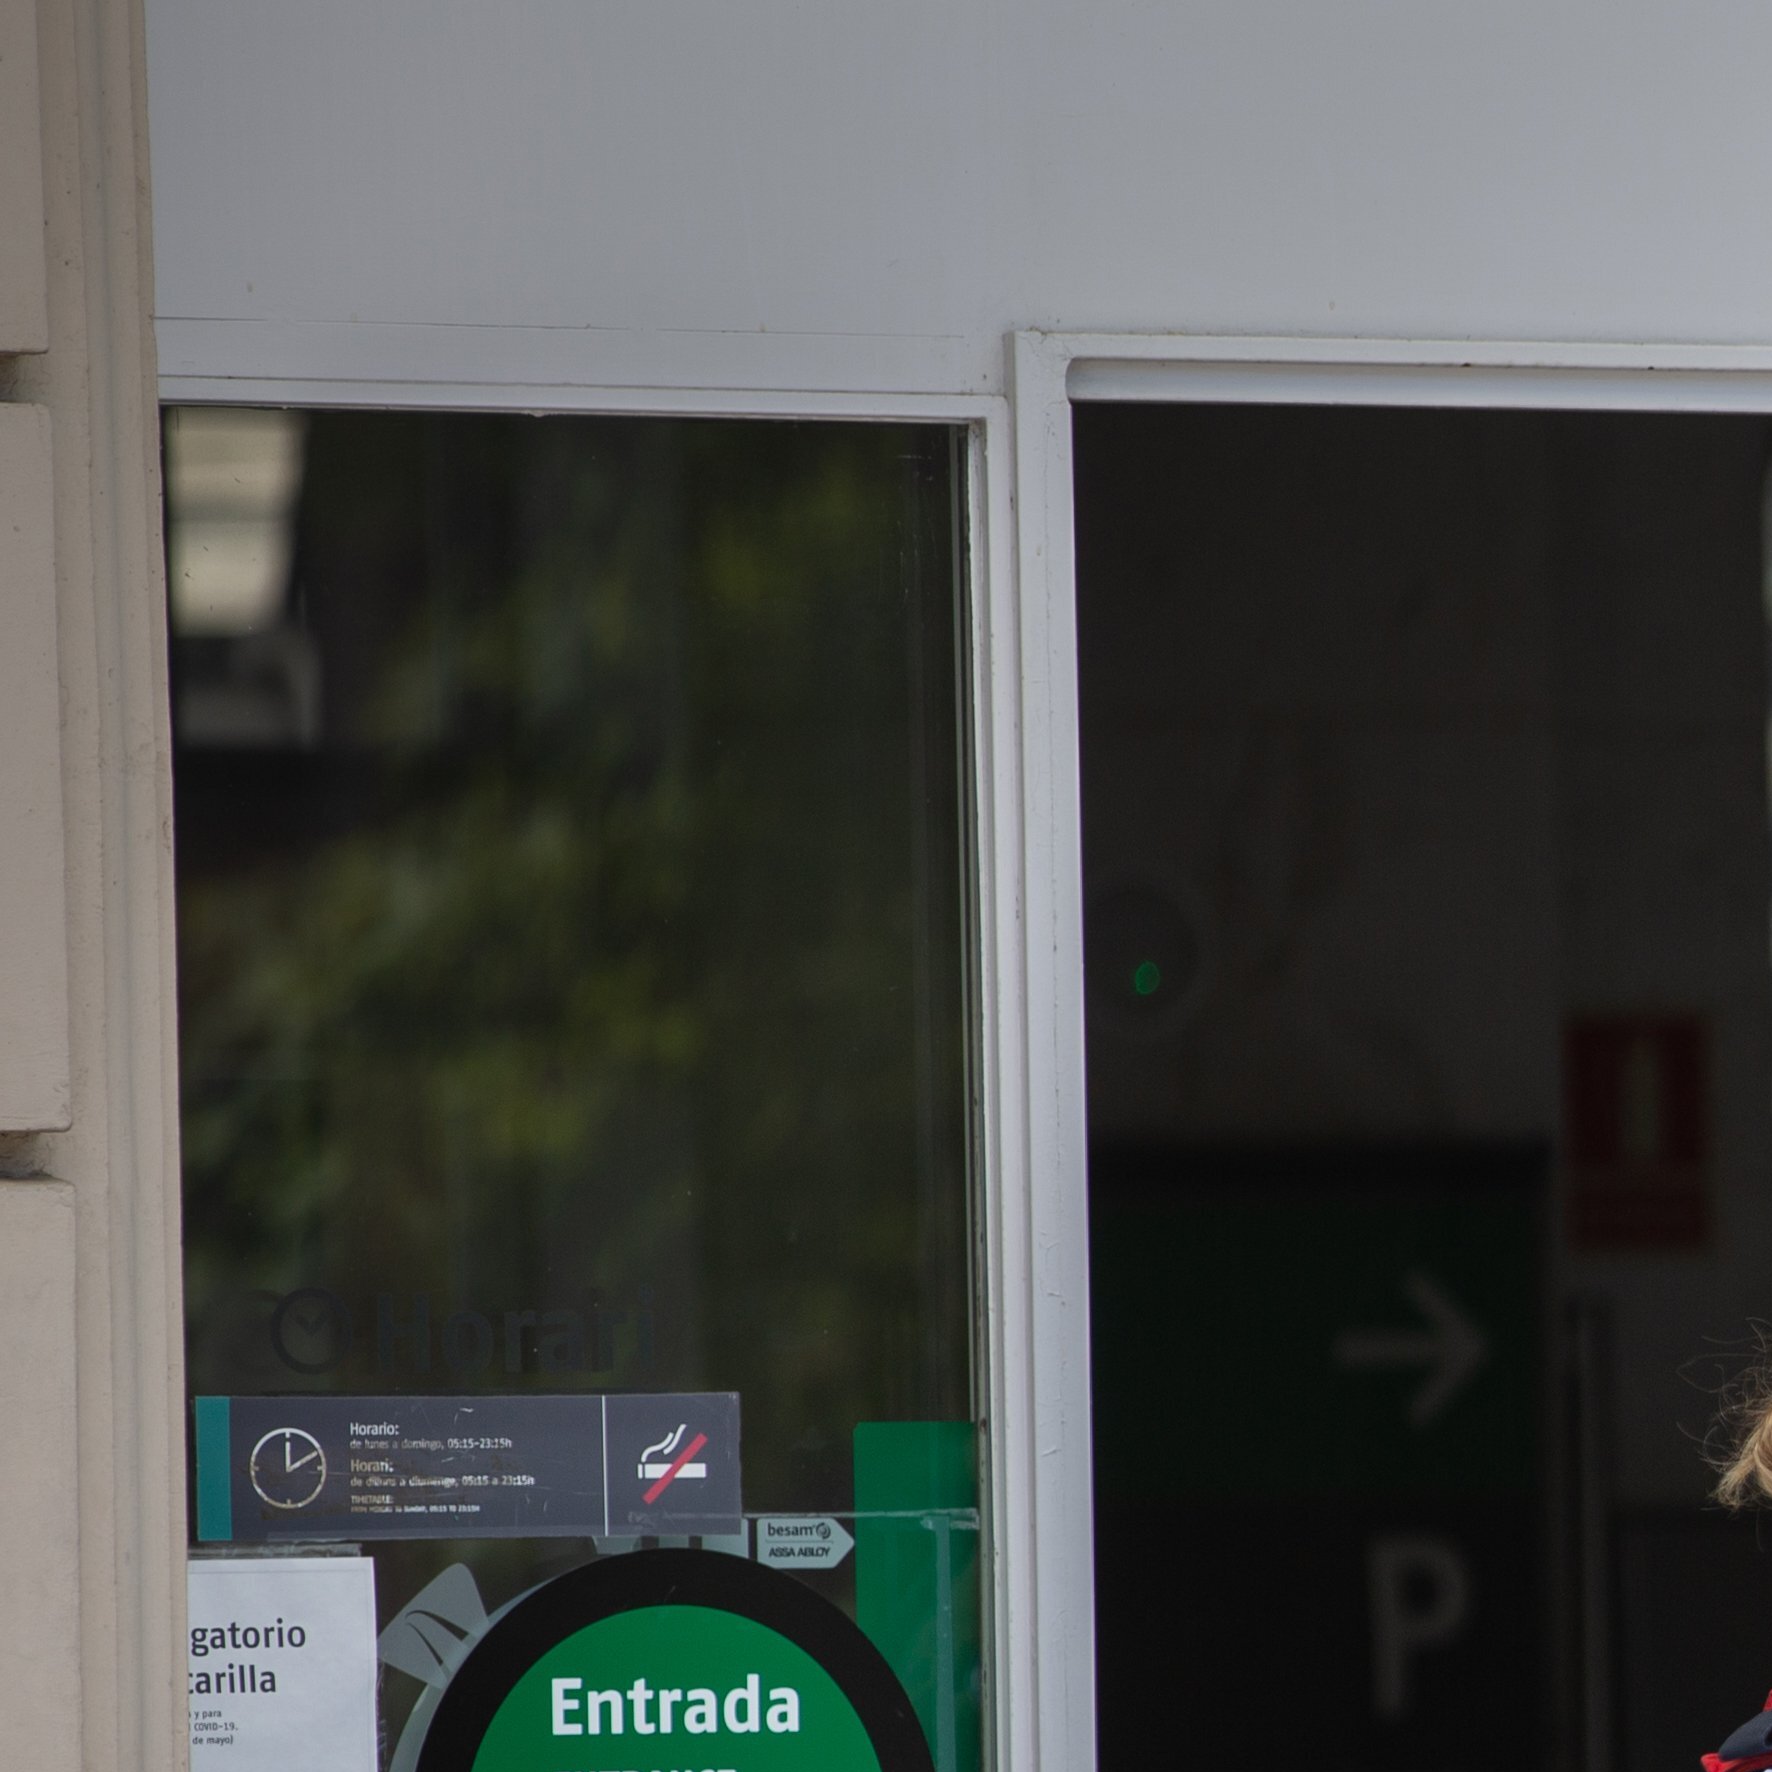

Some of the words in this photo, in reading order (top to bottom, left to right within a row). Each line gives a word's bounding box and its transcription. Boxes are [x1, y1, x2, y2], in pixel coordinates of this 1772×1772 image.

[350, 1422, 400, 1436] Horario:
[350, 1439, 362, 1449] de
[768, 1522, 813, 1536] besam
[769, 1547, 795, 1557] ASSA
[797, 1546, 830, 1557] ABLOY
[1368, 1532, 1474, 1718] P
[191, 1617, 305, 1657] gatorio
[189, 1663, 276, 1694] arilla
[551, 1673, 800, 1735] Entrada
[202, 1710, 221, 1719] para
[194, 1722, 239, 1731] COVID-19.
[192, 1736, 203, 1744] de
[206, 1735, 234, 1746] mayo)
